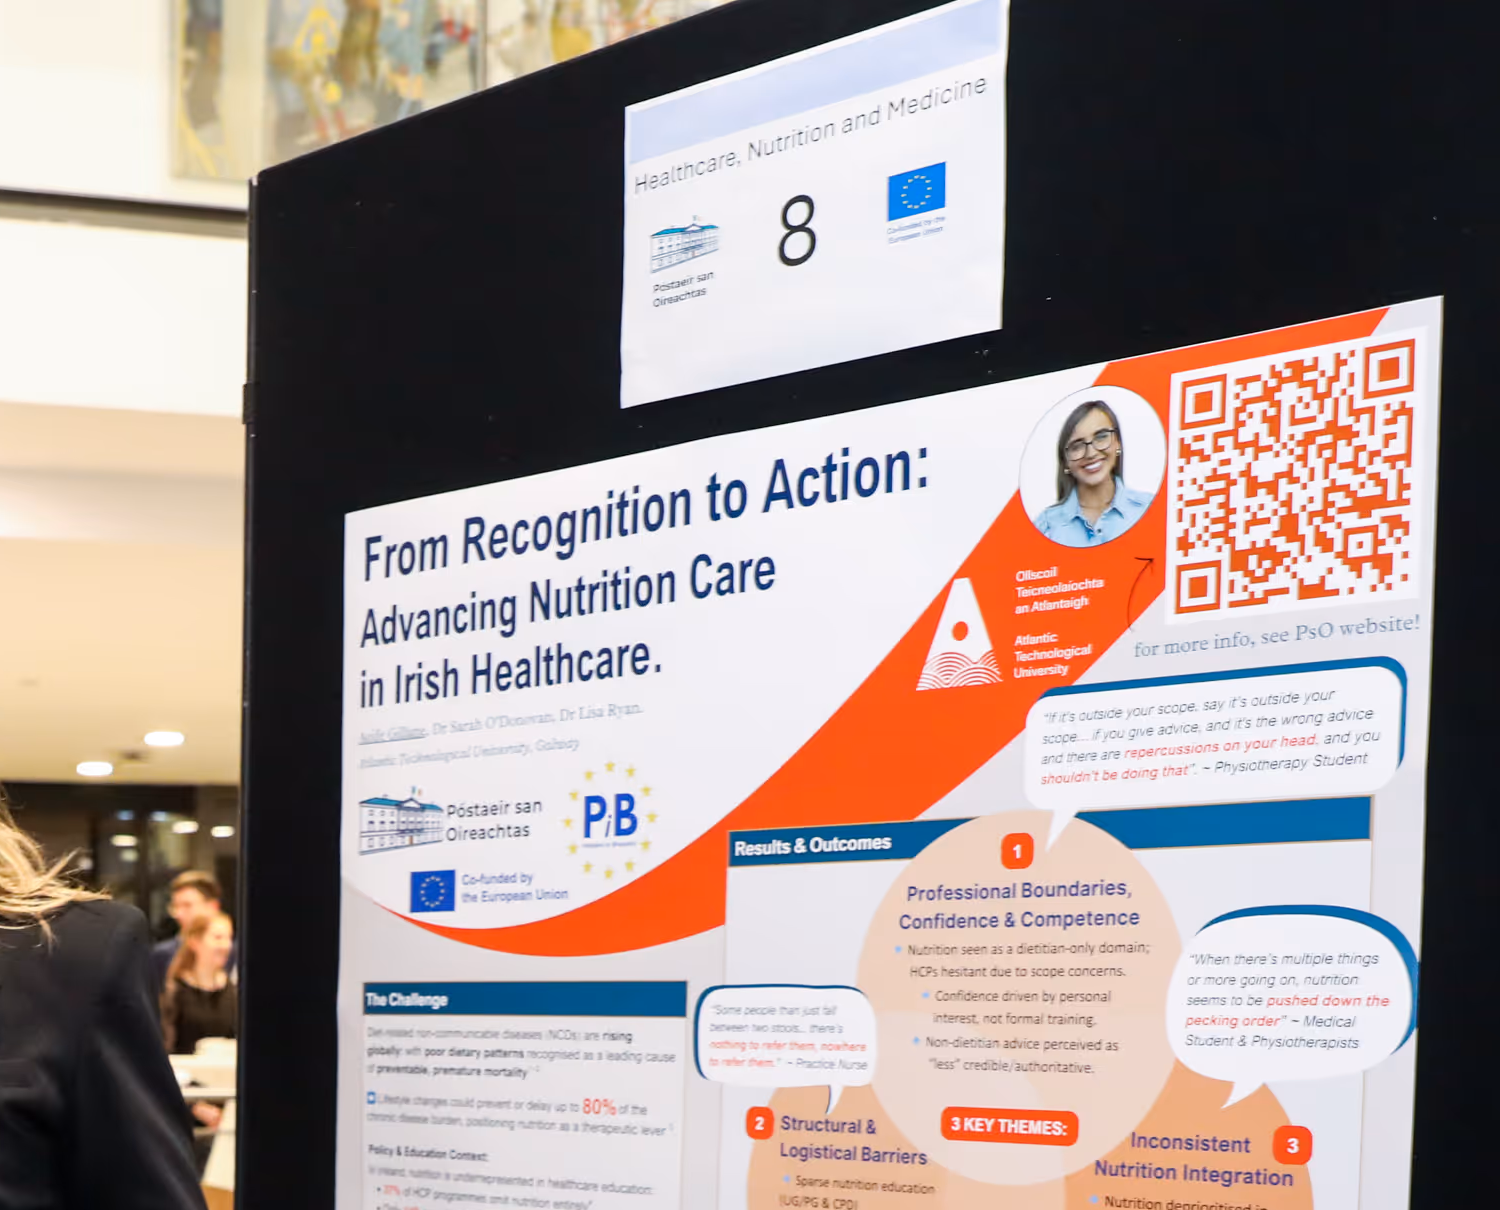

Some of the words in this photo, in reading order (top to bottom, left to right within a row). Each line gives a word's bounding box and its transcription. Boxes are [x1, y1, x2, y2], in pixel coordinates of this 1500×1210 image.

[634, 151, 741, 193] Healthcare,
[747, 122, 834, 160] Nutrition
[841, 104, 880, 134] and
[887, 77, 986, 120] Medicine
[777, 193, 816, 266] 8
[364, 534, 448, 582] From
[462, 486, 691, 564] Recognition
[705, 474, 748, 522] to
[761, 446, 927, 513] Action:
[359, 590, 516, 648] Advancing
[529, 566, 675, 622] Nutrition
[689, 555, 776, 599] Care
[1014, 631, 1058, 646] Atlantic
[1134, 641, 1160, 658] for
[1163, 639, 1209, 655] more
[1213, 630, 1256, 650] info,
[1260, 630, 1290, 644] see
[1294, 621, 1334, 641] PsO
[1338, 613, 1420, 635] website!
[1013, 643, 1092, 662] Technological
[360, 669, 383, 708] in
[395, 657, 458, 704] Irish
[471, 642, 661, 694] Healthcare.
[1013, 663, 1069, 678] University
[446, 799, 511, 818] Póstaeir
[514, 800, 542, 814] san
[446, 824, 530, 842] Oireachtas
[734, 839, 791, 858] Results
[793, 837, 807, 855] &
[809, 834, 892, 854] Outcomes
[1012, 843, 1022, 859] 1
[907, 882, 1016, 901] Professional
[1021, 878, 1131, 898] Boundaries,
[898, 912, 999, 930] Confidence
[1003, 911, 1016, 928] &
[1020, 910, 1140, 931] Competence
[1281, 952, 1334, 966] multiple
[1337, 952, 1379, 968] things
[1186, 975, 1202, 986] or
[1203, 975, 1236, 986] more
[1239, 975, 1276, 989] going
[1279, 975, 1298, 986] on,
[1303, 973, 1359, 986] nutrition
[366, 993, 389, 1007] The
[389, 993, 449, 1010] Challenge
[1186, 996, 1227, 1006] seems
[1230, 995, 1243, 1006] to
[1246, 994, 1263, 1006] be
[1266, 994, 1319, 1008] pushed
[1321, 994, 1362, 1006] down
[1365, 994, 1390, 1007] the
[1184, 1014, 1239, 1029] pecking
[1303, 1014, 1356, 1028] Medical
[1184, 1033, 1234, 1047] Student
[1236, 1034, 1247, 1047] &
[1251, 1034, 1359, 1050] Physiotherapists
[582, 1098, 618, 1116] 80%
[754, 1115, 765, 1130] 2
[780, 1114, 861, 1134] Structural
[865, 1118, 876, 1135] &
[950, 1117, 961, 1132] 3
[963, 1117, 995, 1134] KEY
[998, 1118, 1069, 1138] THEMES:
[1130, 1131, 1251, 1154] Inconsistent
[1286, 1137, 1299, 1154] 3
[779, 1142, 857, 1162] Logistical
[860, 1145, 928, 1165] Barriers
[1094, 1159, 1176, 1180] Nutrition
[1182, 1163, 1294, 1187] Integration
[1104, 1195, 1162, 1210] Nutrition
